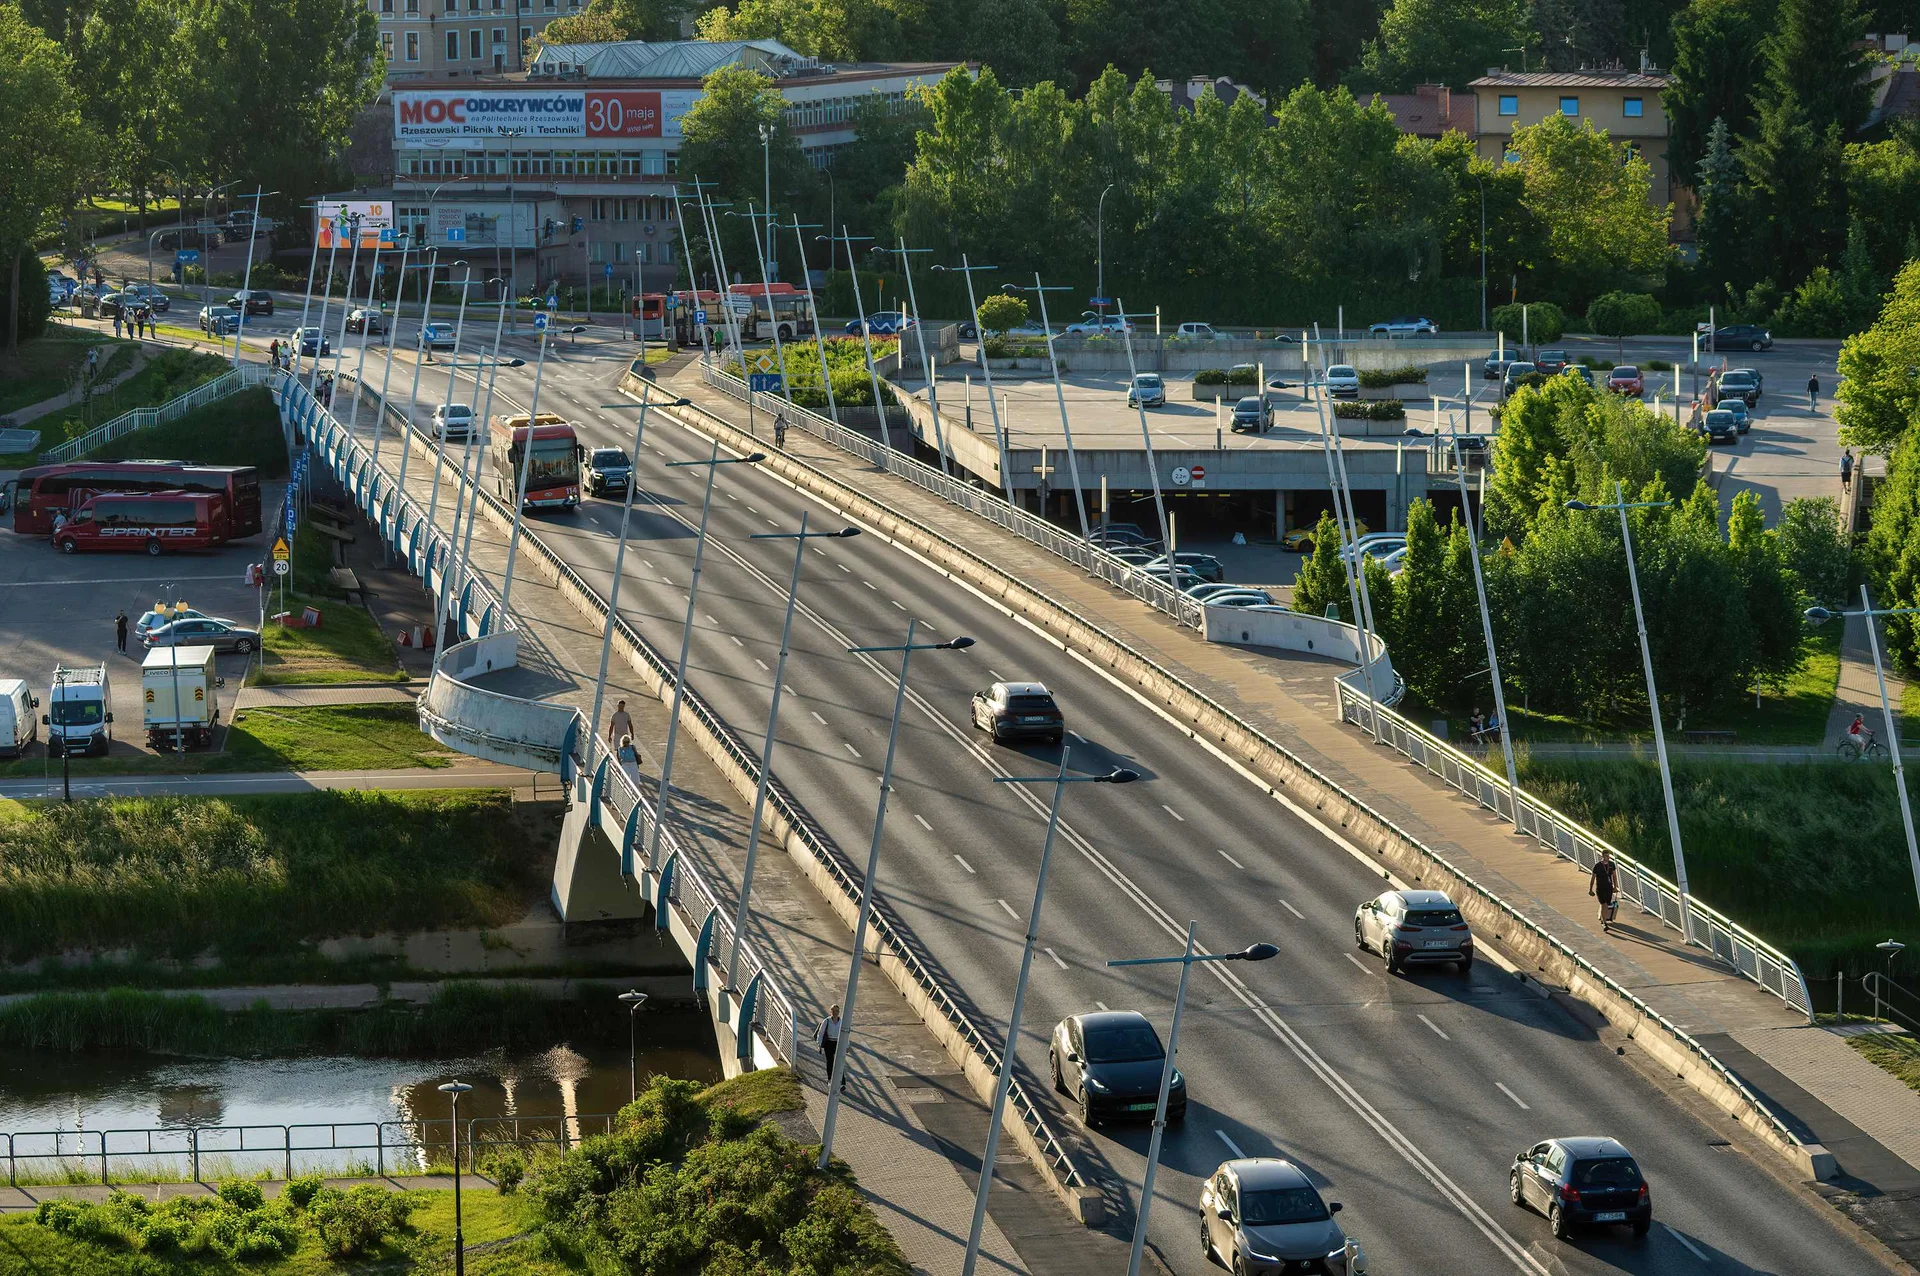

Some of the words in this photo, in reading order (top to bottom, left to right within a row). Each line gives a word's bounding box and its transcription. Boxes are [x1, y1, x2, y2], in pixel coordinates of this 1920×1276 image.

[400, 99, 466, 124] MOC
[466, 95, 584, 112] ODKRYWCÓW
[529, 115, 580, 123] Rzeszowskiej
[589, 98, 623, 132] 30
[626, 106, 655, 121] maja
[401, 126, 460, 135] Rzeszowski
[463, 125, 494, 134] Piknik
[497, 125, 528, 134] Nauki
[530, 125, 534, 134] i
[537, 125, 580, 134] Techniki
[696, 312, 705, 322] P
[99, 527, 197, 537] SPRINTER
